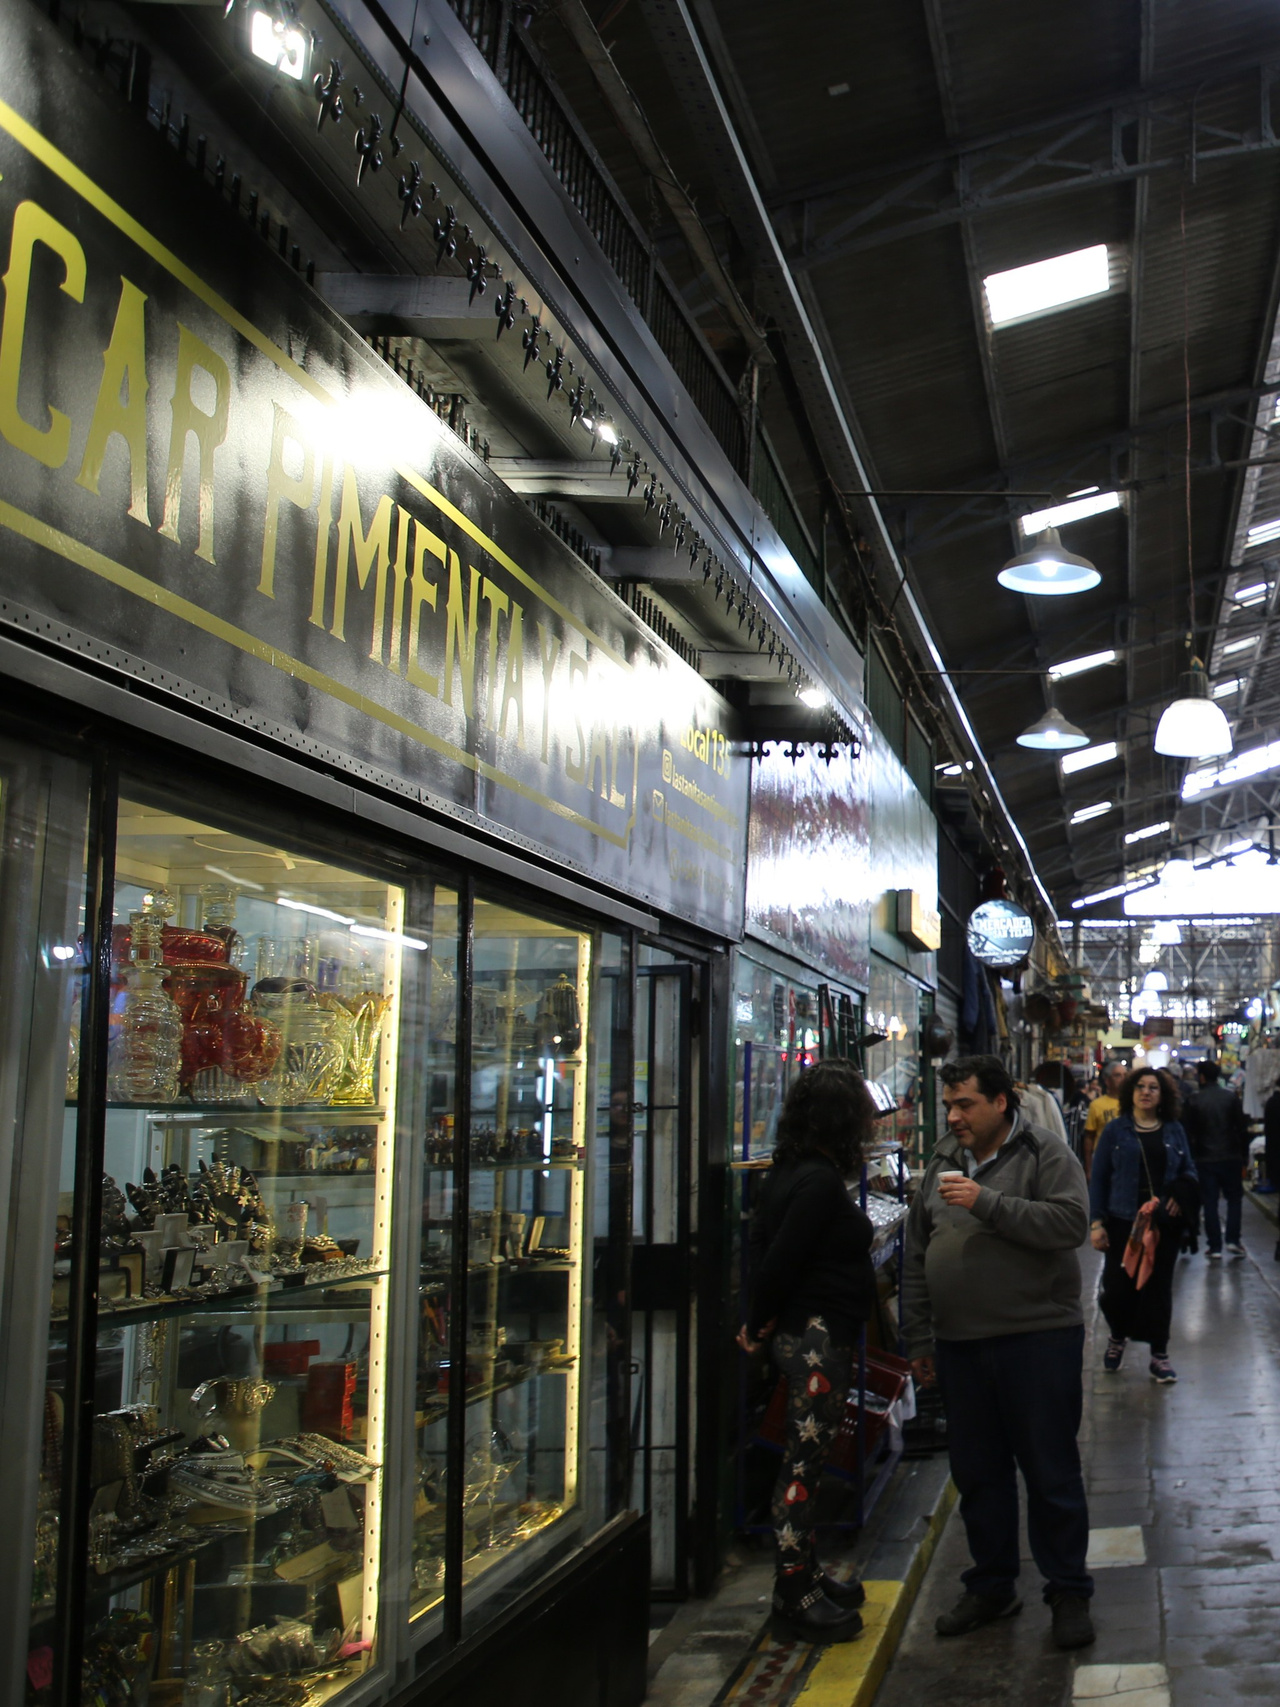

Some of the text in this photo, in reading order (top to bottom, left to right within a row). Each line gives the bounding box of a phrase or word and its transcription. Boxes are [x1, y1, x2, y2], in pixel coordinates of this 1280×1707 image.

[256, 399, 525, 752] PIMIENTA
[536, 621, 562, 766] Y
[711, 729, 732, 781] 135
